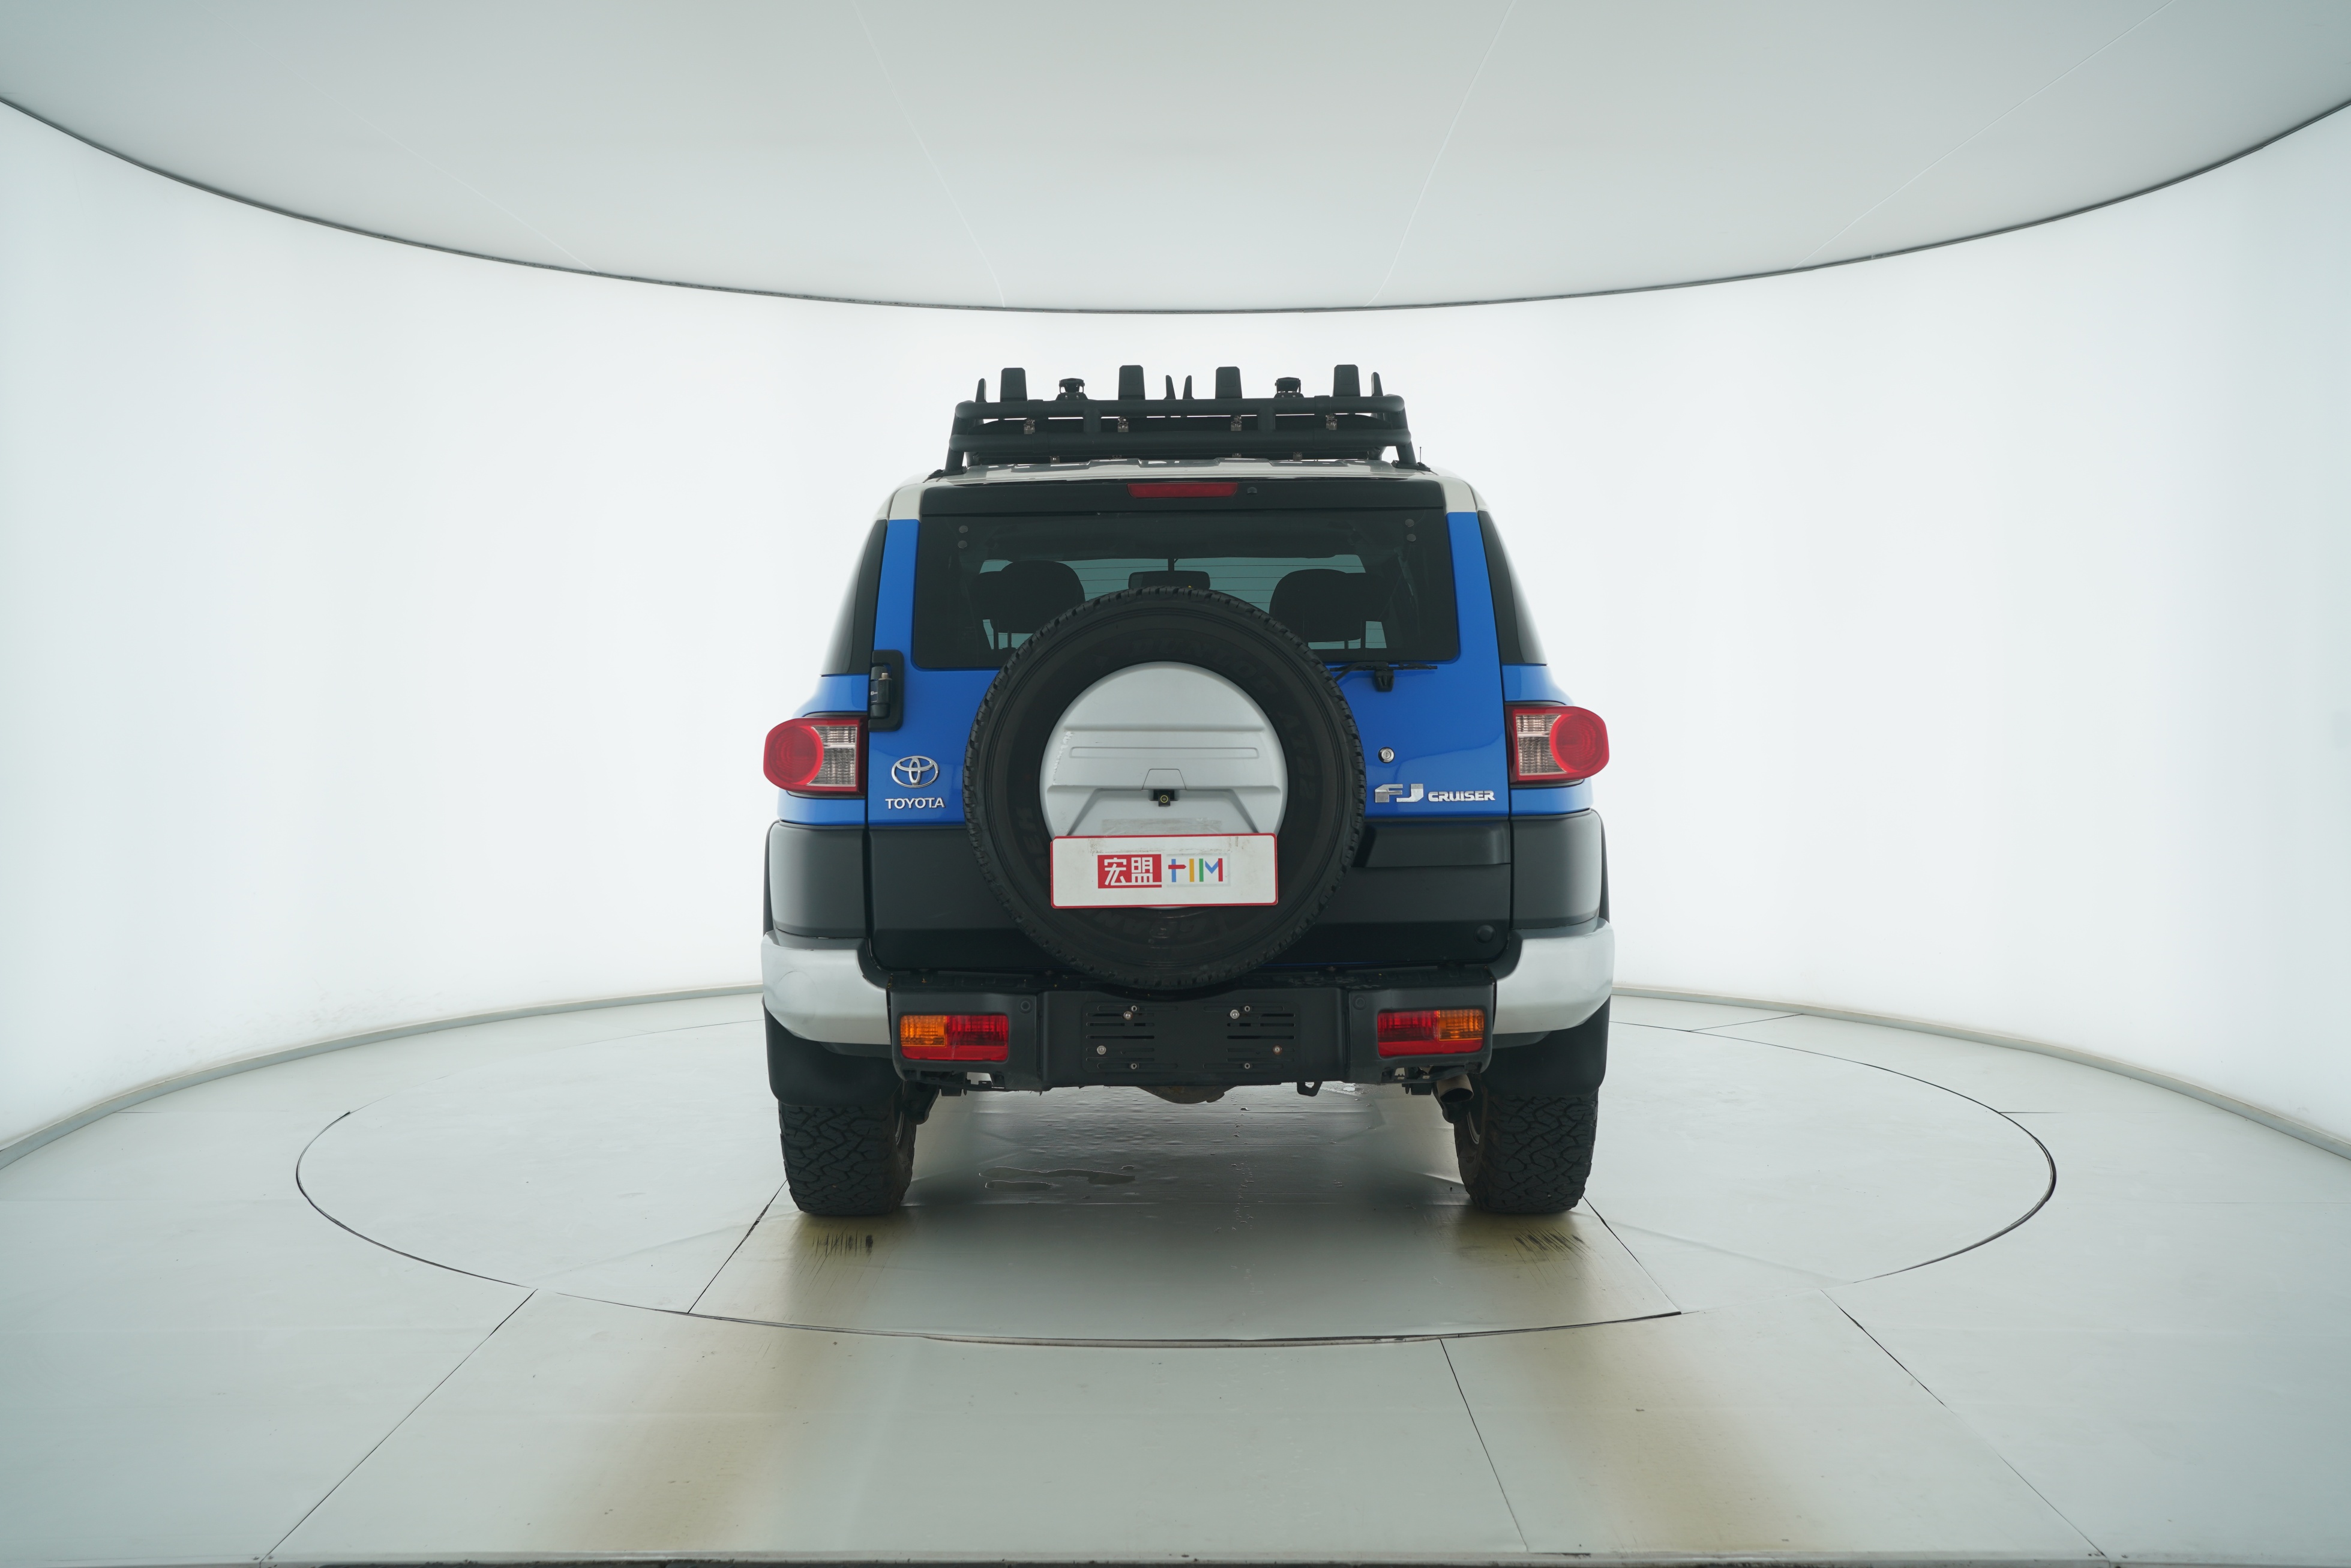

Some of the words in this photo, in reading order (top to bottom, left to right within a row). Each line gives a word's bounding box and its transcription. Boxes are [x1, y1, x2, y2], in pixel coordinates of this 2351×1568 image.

[1129, 637, 1279, 695] DUNLOP
[885, 797, 946, 810] TOYOTA
[1375, 783, 1424, 803] FJ
[1428, 790, 1496, 802] CRUISER
[1103, 857, 1160, 886] 宏盟
